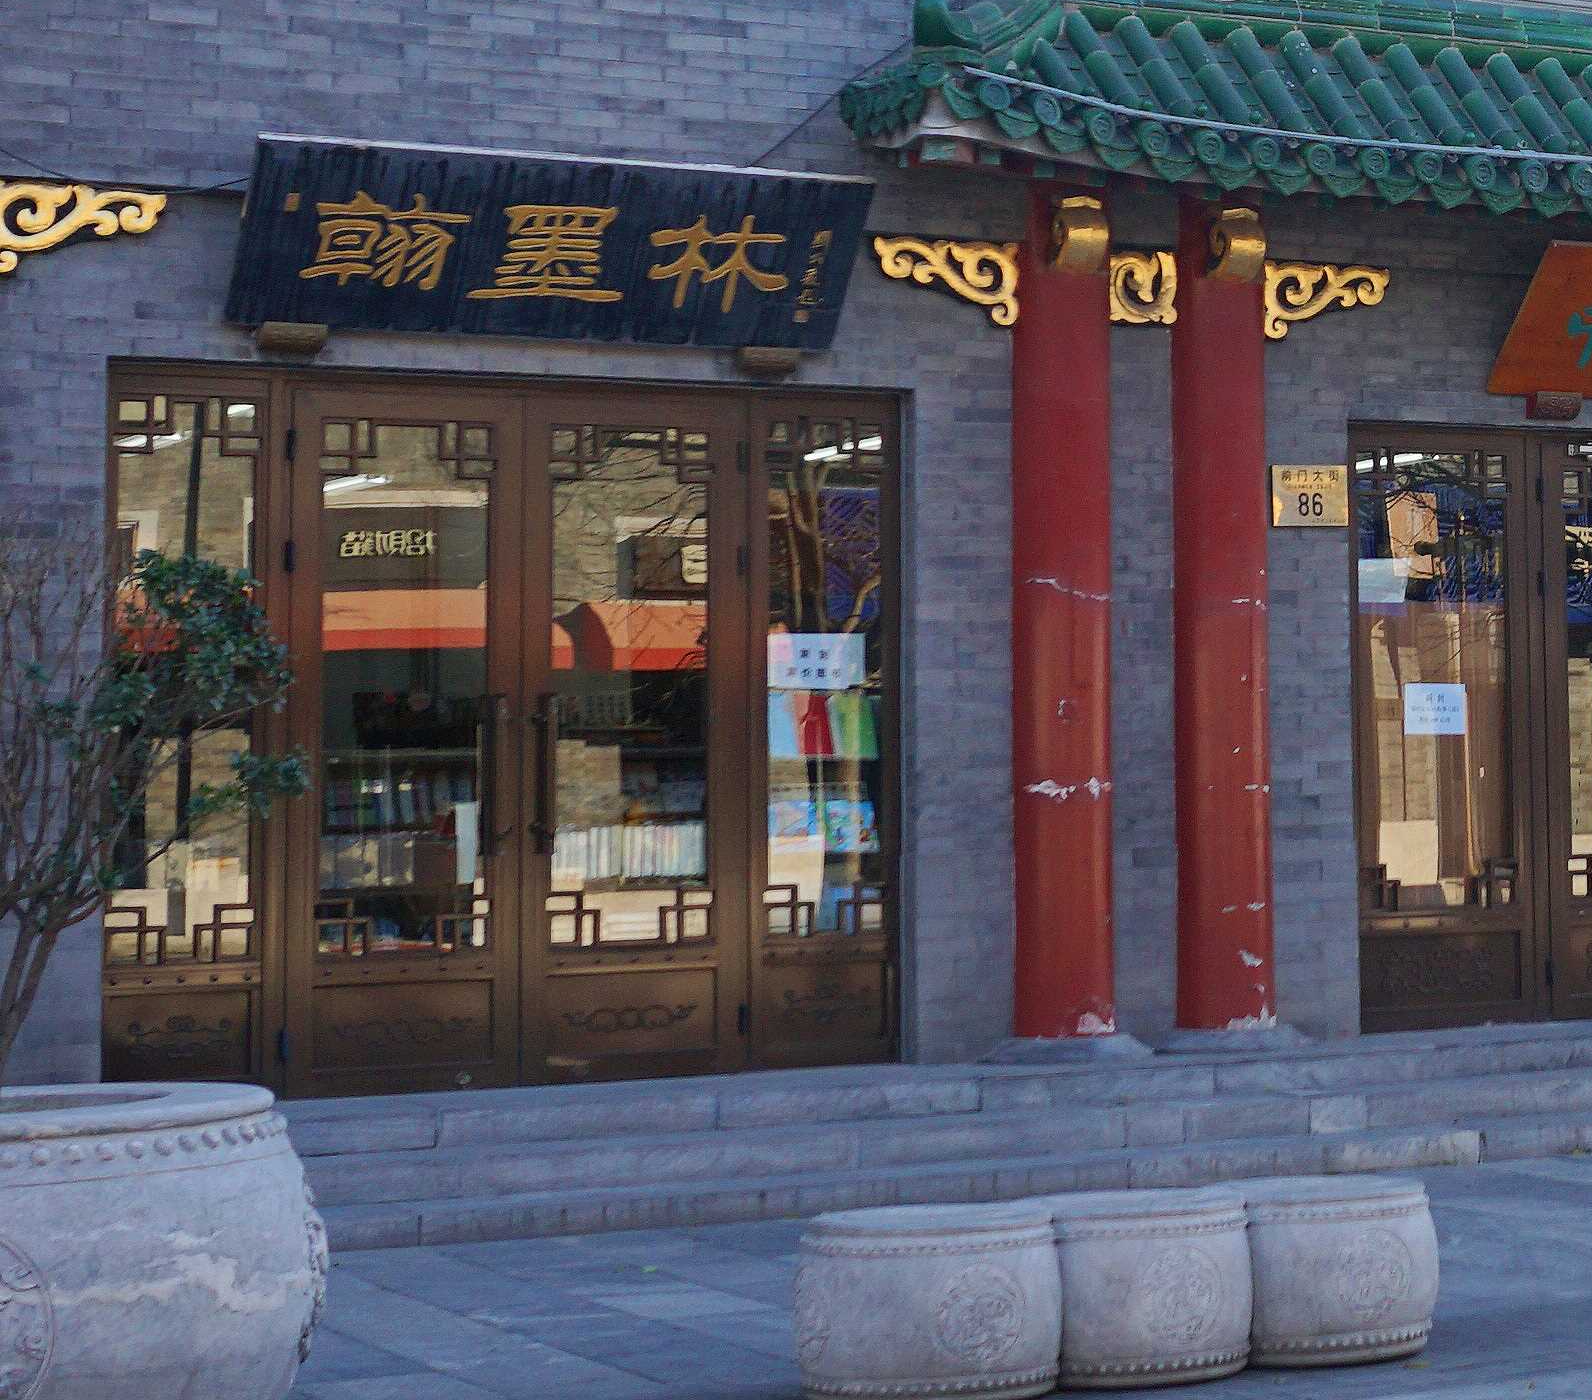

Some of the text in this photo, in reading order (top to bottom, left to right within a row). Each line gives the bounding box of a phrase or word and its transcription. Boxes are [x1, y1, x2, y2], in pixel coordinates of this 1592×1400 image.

[299, 190, 790, 314] 翰墨林
[1298, 492, 1323, 517] 86
